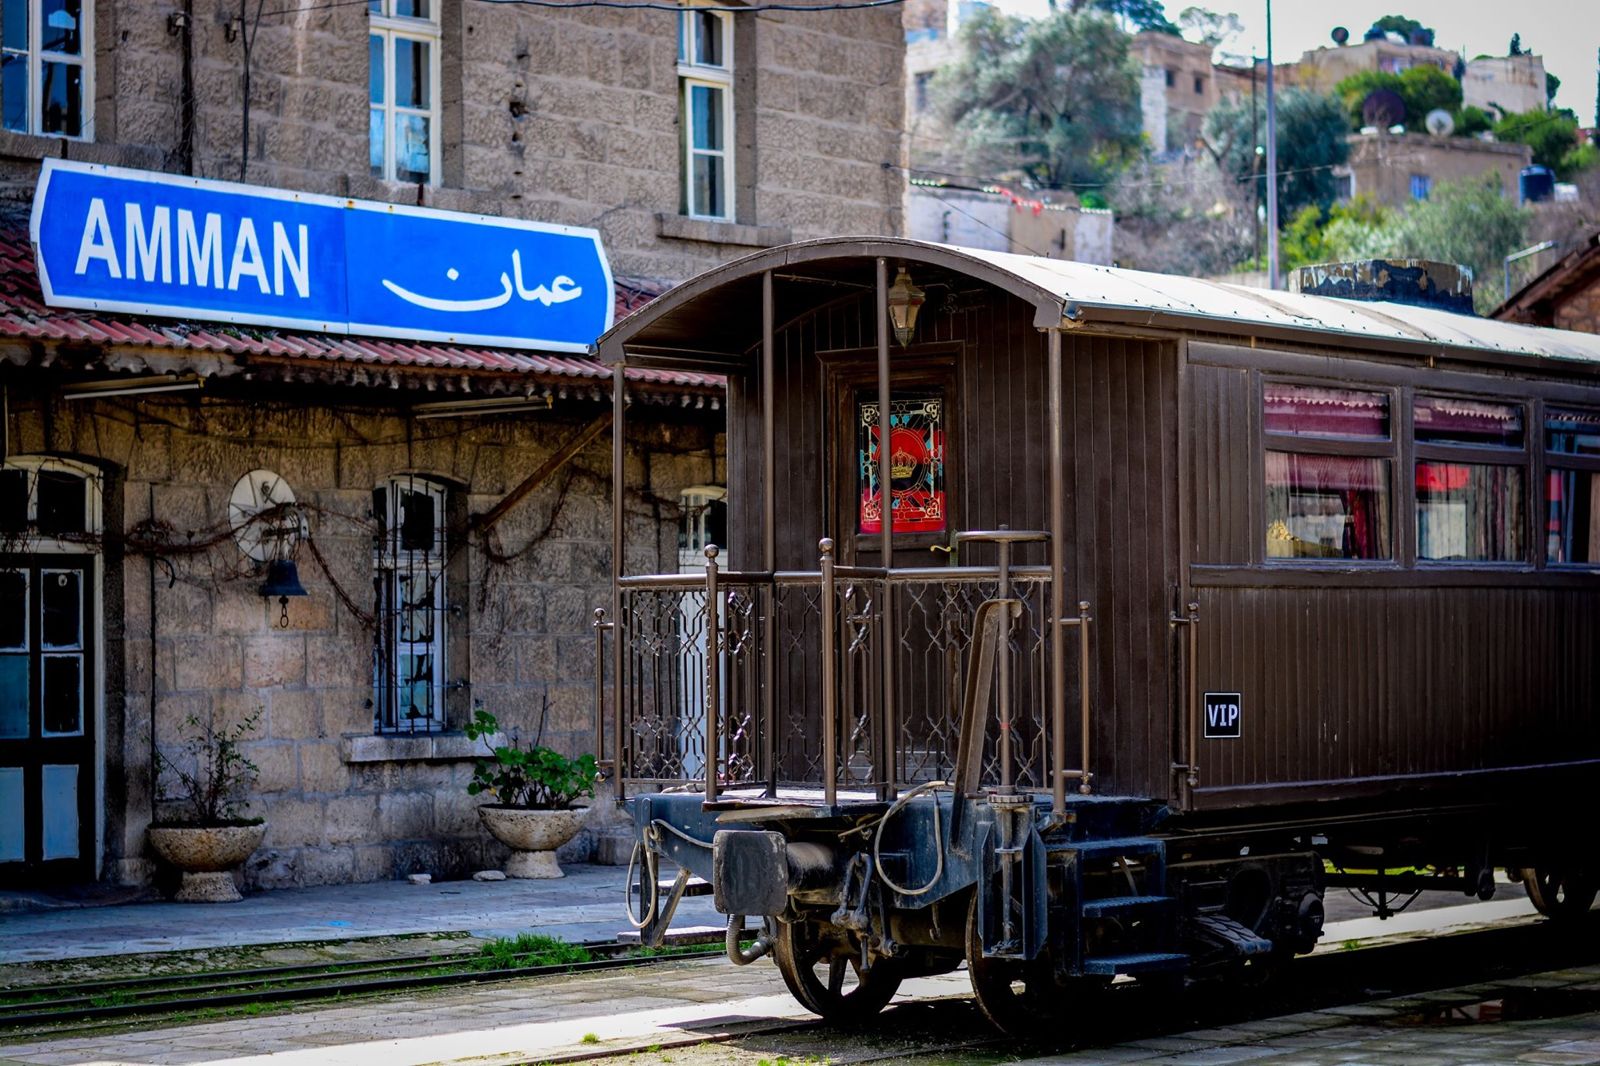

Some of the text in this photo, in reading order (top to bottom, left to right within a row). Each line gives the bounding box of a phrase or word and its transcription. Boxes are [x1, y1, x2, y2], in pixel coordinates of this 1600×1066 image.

[75, 198, 310, 298] AMMAN
[382, 249, 582, 312] عمان
[1207, 703, 1238, 727] VIP
